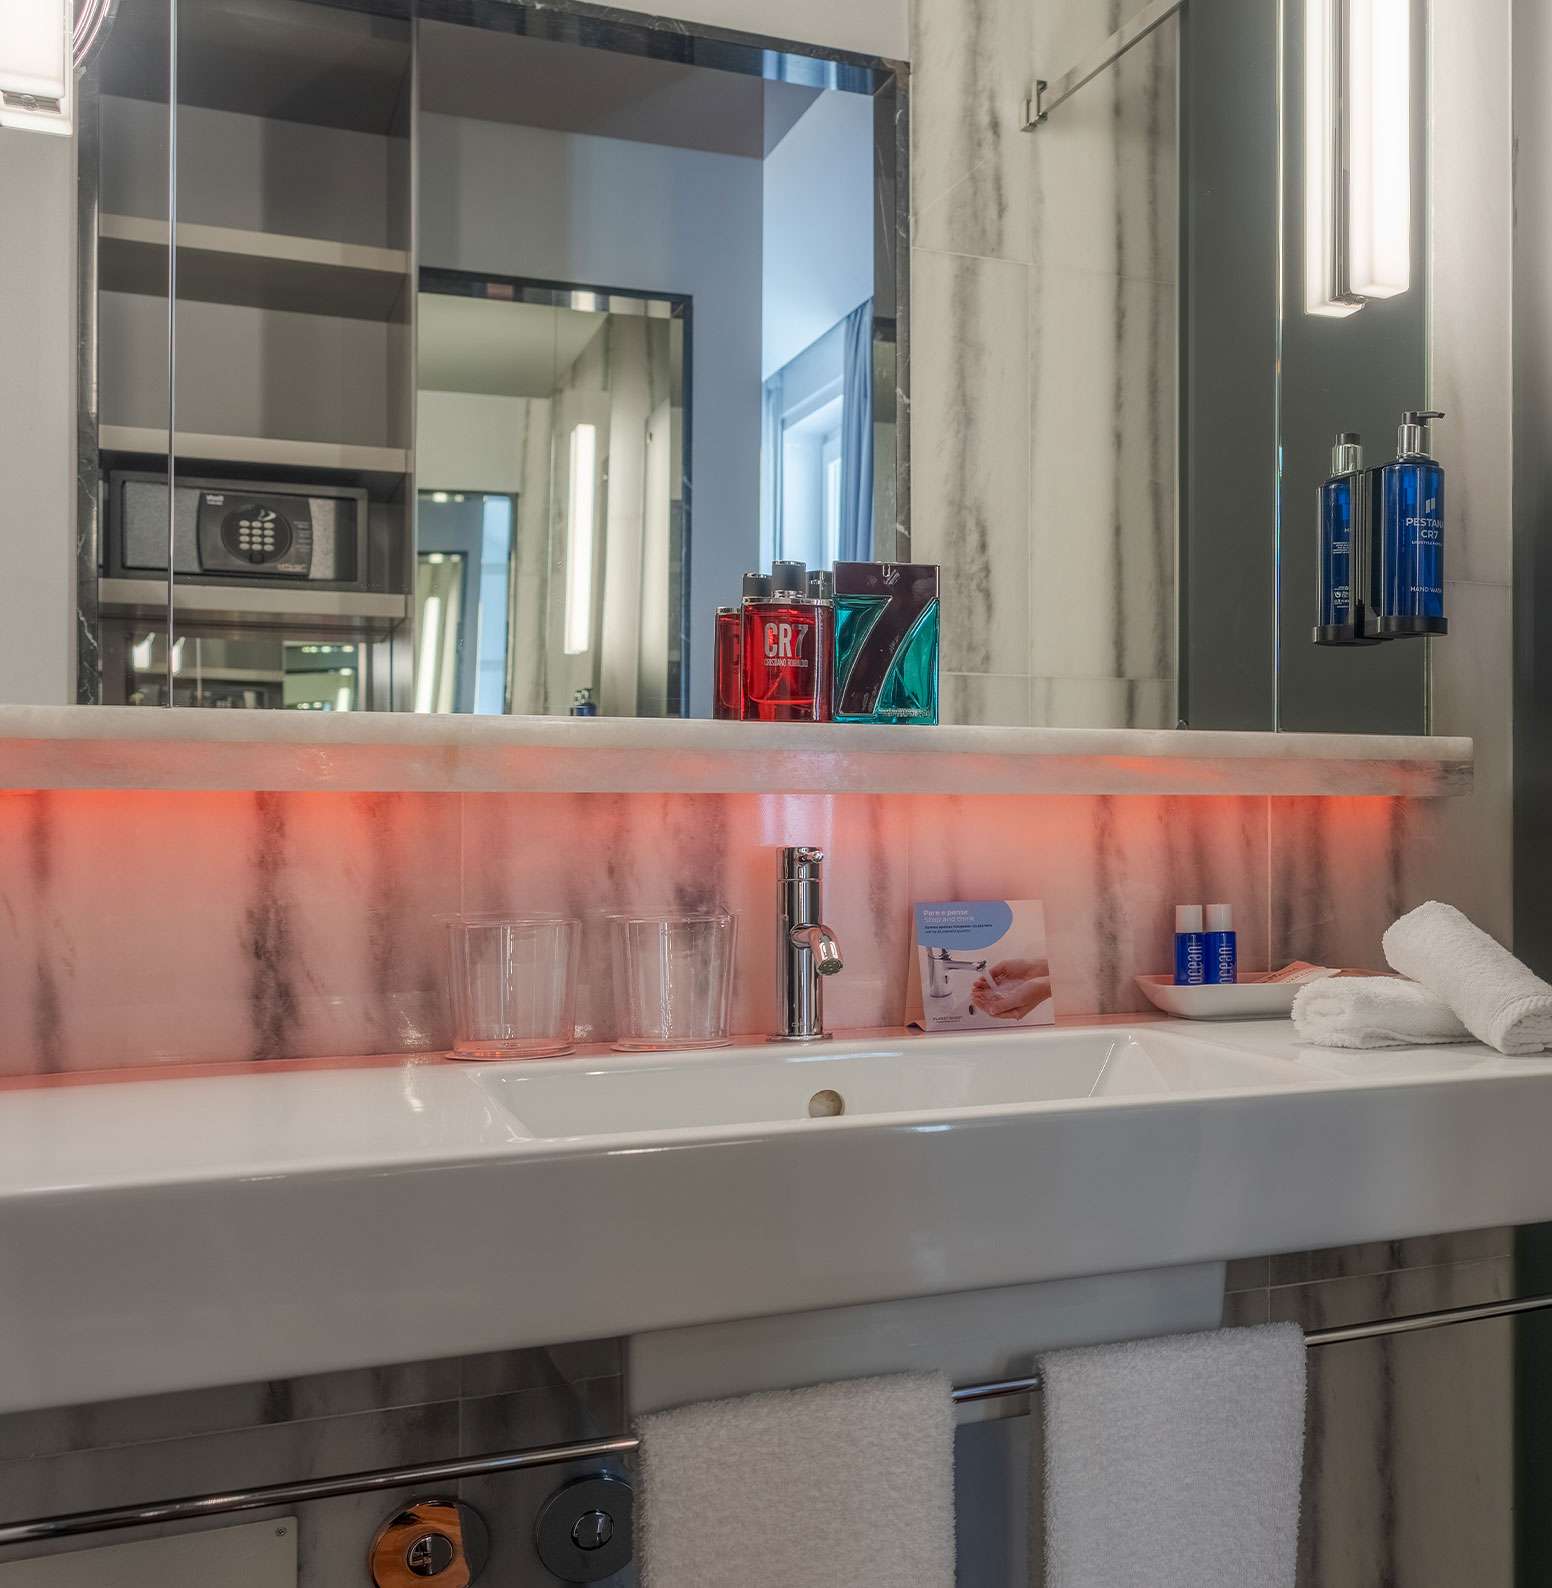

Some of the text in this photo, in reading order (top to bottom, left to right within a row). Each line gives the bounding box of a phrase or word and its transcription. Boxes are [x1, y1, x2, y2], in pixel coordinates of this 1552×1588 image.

[1406, 517, 1445, 528] PESTAN
[1421, 530, 1439, 539] CR7
[764, 622, 809, 659] CR7
[1187, 944, 1204, 984] ocean
[1218, 946, 1234, 984] ocean
